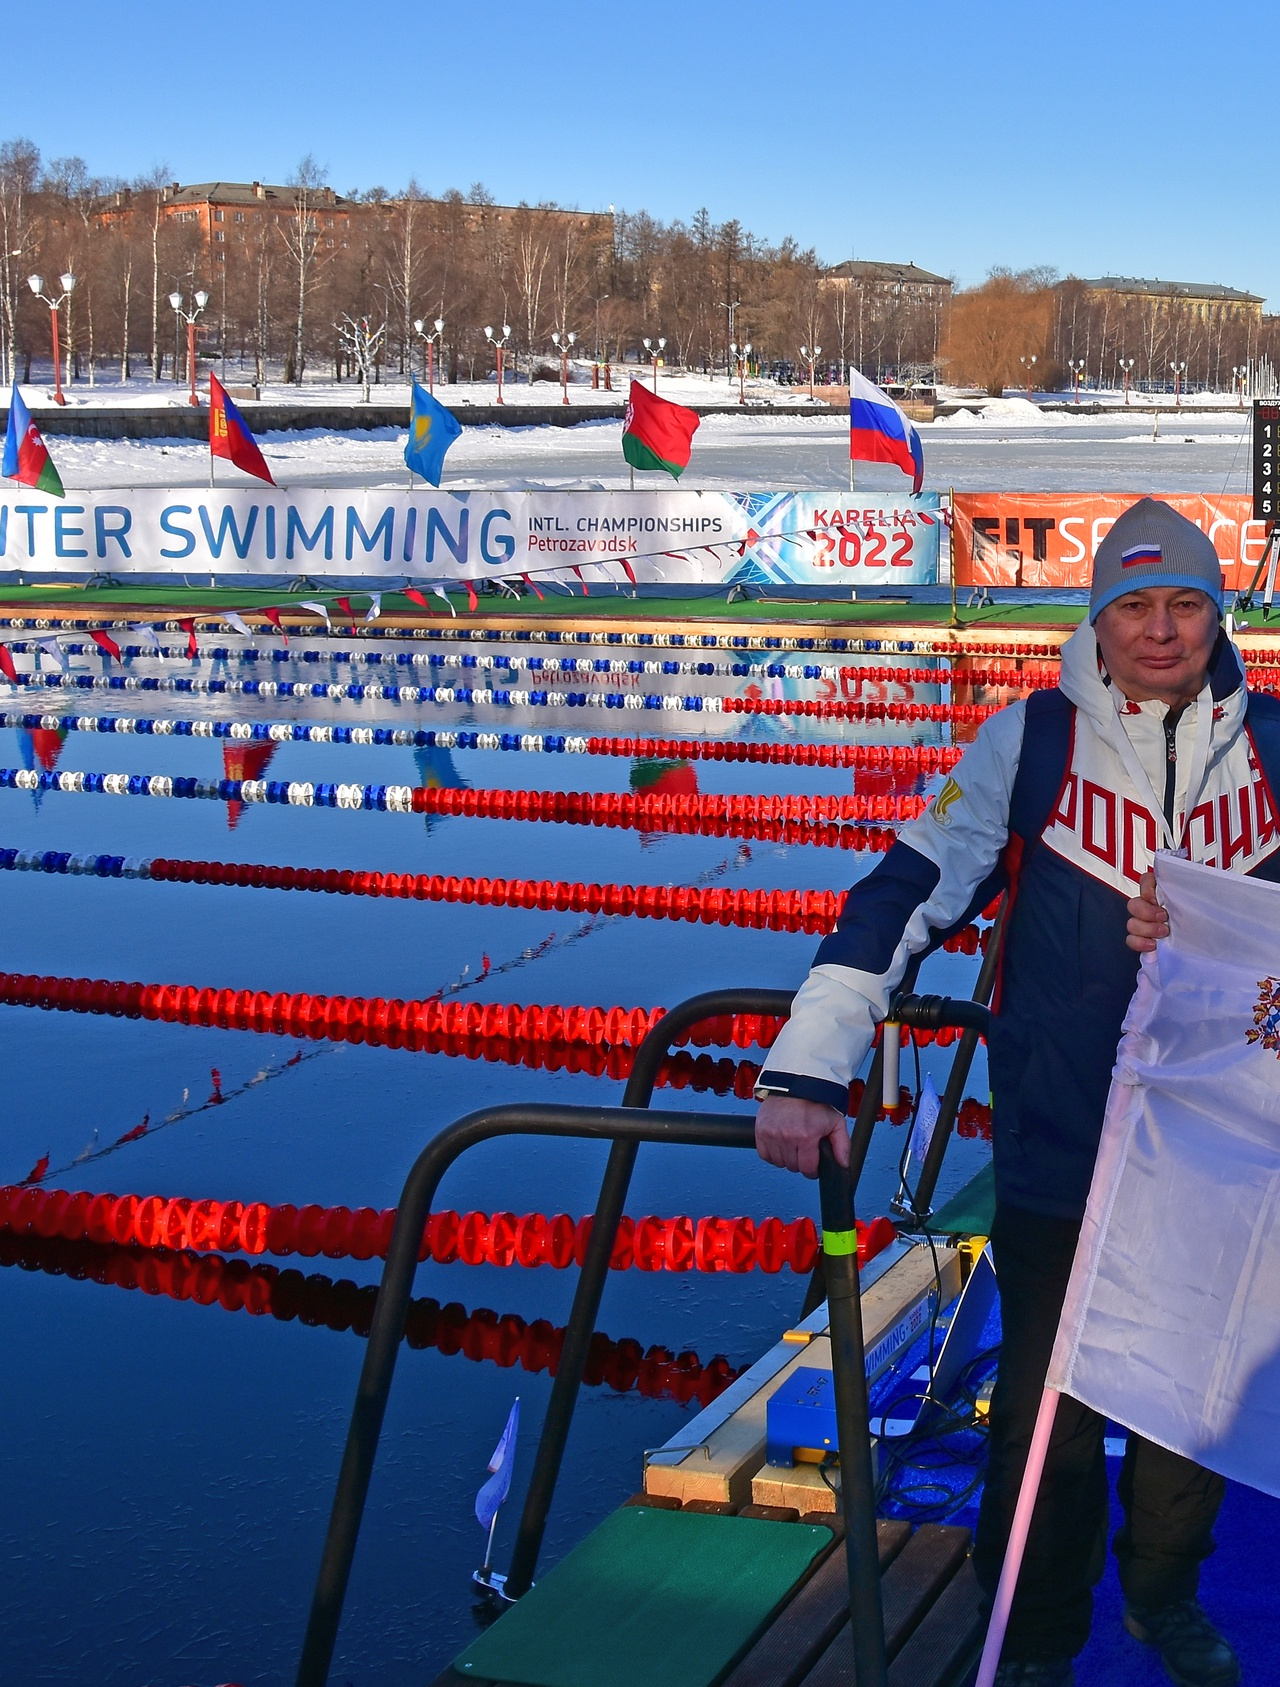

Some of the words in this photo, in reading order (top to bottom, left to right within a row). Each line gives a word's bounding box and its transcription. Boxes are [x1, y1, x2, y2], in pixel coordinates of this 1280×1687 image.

[1263, 424, 1272, 438] 1
[1262, 444, 1272, 457] 2
[1262, 463, 1272, 476] 3
[1262, 481, 1272, 495] 4
[1262, 500, 1272, 514] 5
[528, 516, 569, 532] INTL.
[576, 516, 723, 533] CHAMPIONSHIPS
[814, 509, 916, 527] KARELIA
[160, 504, 516, 565] SWIMMING
[528, 534, 637, 552] Petrozavodsk
[813, 532, 914, 567] 2022
